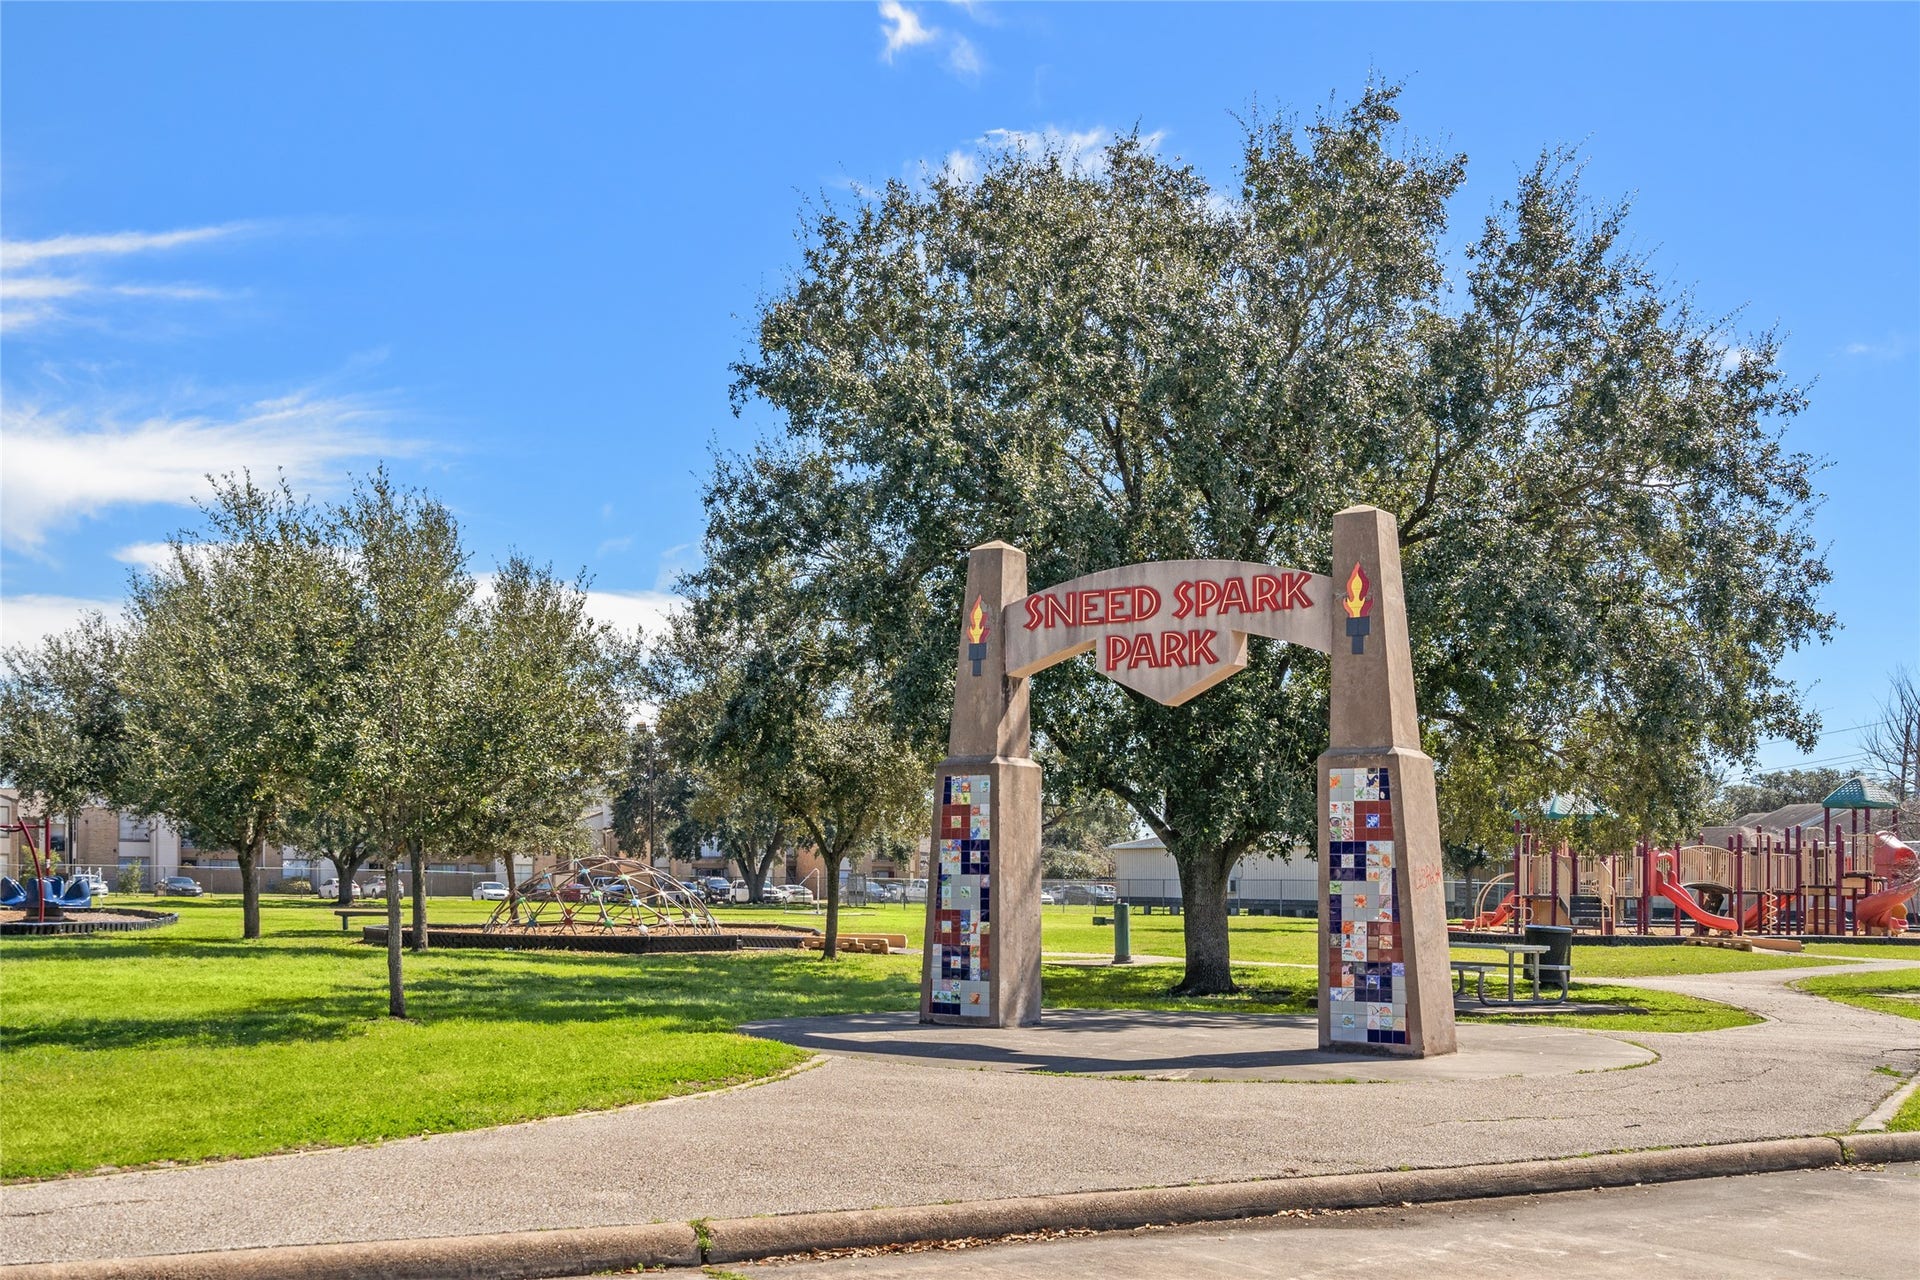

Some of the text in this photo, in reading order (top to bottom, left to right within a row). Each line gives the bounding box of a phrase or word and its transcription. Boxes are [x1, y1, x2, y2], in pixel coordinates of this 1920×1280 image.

[1024, 572, 1313, 631] SNEED SPARK
[1105, 629, 1219, 672] PARK
